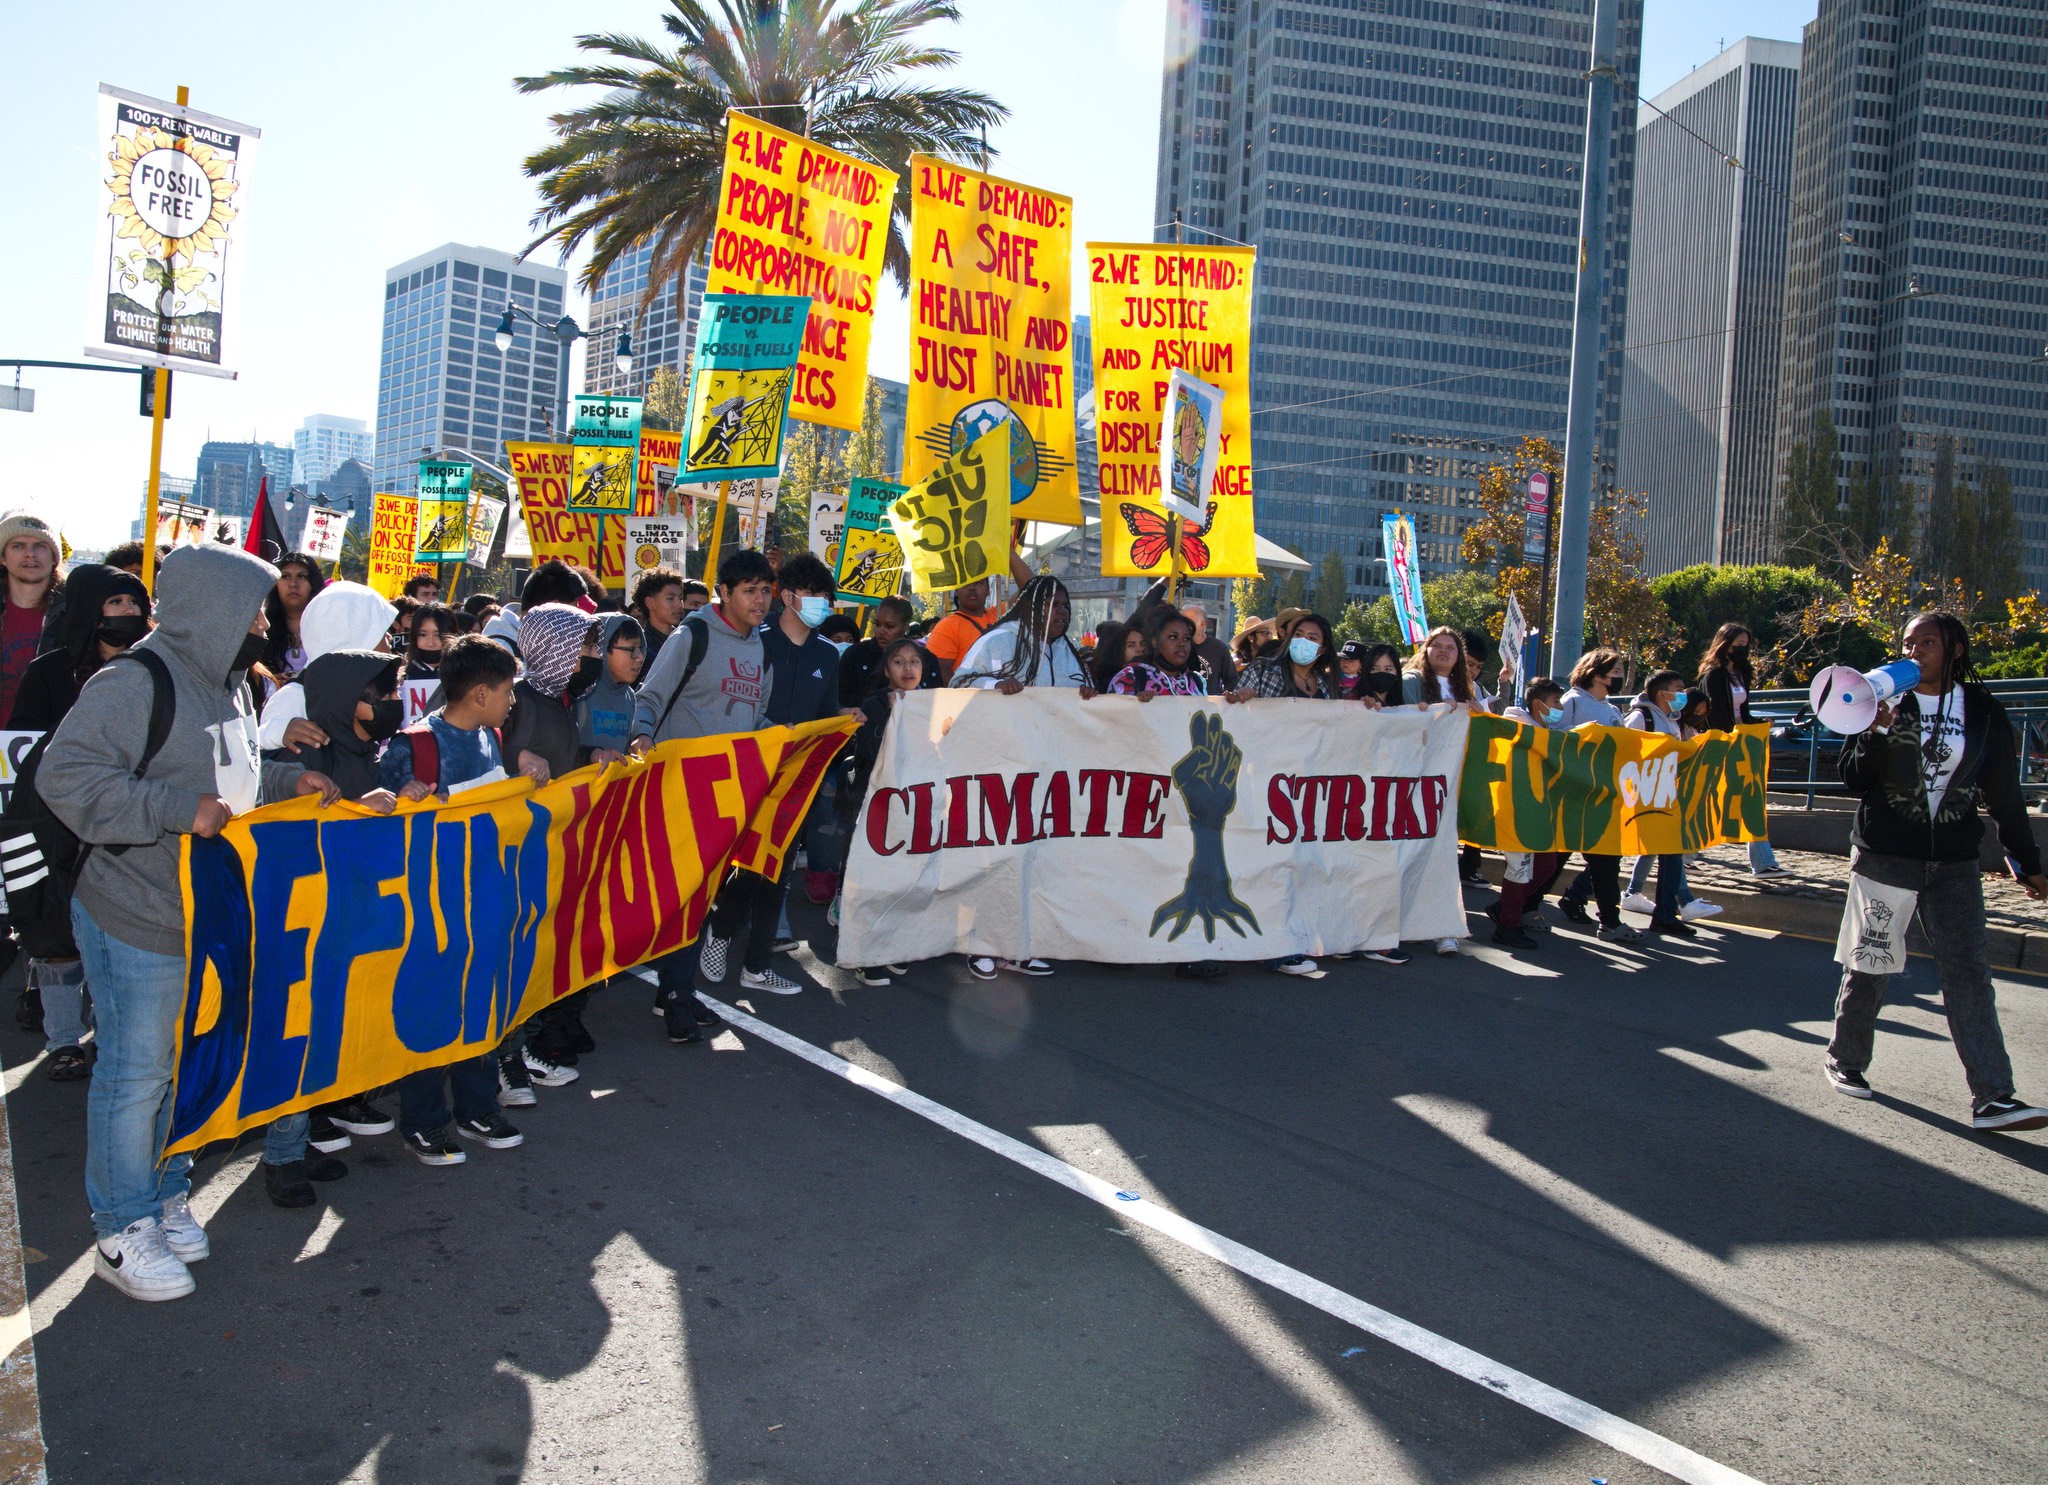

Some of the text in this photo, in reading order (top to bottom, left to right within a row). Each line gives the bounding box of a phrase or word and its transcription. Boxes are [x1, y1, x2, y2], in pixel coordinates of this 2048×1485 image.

[127, 109, 233, 147] 100% RENEWABLE
[142, 164, 203, 198] FOSSIL
[797, 147, 884, 206] DEMAND:
[149, 192, 194, 220] FREE
[726, 172, 873, 260] PEOPLE, NOT
[978, 181, 1066, 228] DEMAND:
[713, 226, 874, 317] CORPORATIONS,
[932, 223, 1050, 293] A SAFE,
[1155, 256, 1244, 290] DEMAND:
[113, 309, 216, 342] PROTECT OUR WATER,
[715, 305, 794, 325] PEOPLE
[920, 278, 1067, 352] HEALTHY AND
[1121, 297, 1208, 331] JUSTICE
[116, 325, 211, 355] CLIMATE AND HEALTH
[701, 341, 794, 358] FOSSIL FUELS
[1102, 339, 1233, 373] AND ASYLUM
[914, 336, 1063, 409] JUST PLANET
[581, 405, 629, 418] PEOPLE
[1105, 390, 1141, 412] FOR
[574, 428, 633, 439] FOSSIL FUELS
[427, 467, 465, 478] PEOPLE
[1100, 463, 1162, 495] CLIMA
[1174, 460, 1197, 480] STOP
[422, 486, 468, 495] FOSSIL FUELS
[376, 512, 409, 530] POLICY
[850, 509, 881, 522] FOSSI
[372, 549, 384, 560] OFF
[386, 551, 412, 565] FOSSIL
[374, 530, 416, 552] ON SCIE
[375, 562, 383, 574] IN
[384, 564, 403, 576] 5-10
[1458, 716, 1618, 851] FUND
[1619, 751, 1680, 809] OUR
[865, 768, 1448, 857] CLIMATE STRIKE
[164, 798, 551, 1153] DEFUND
